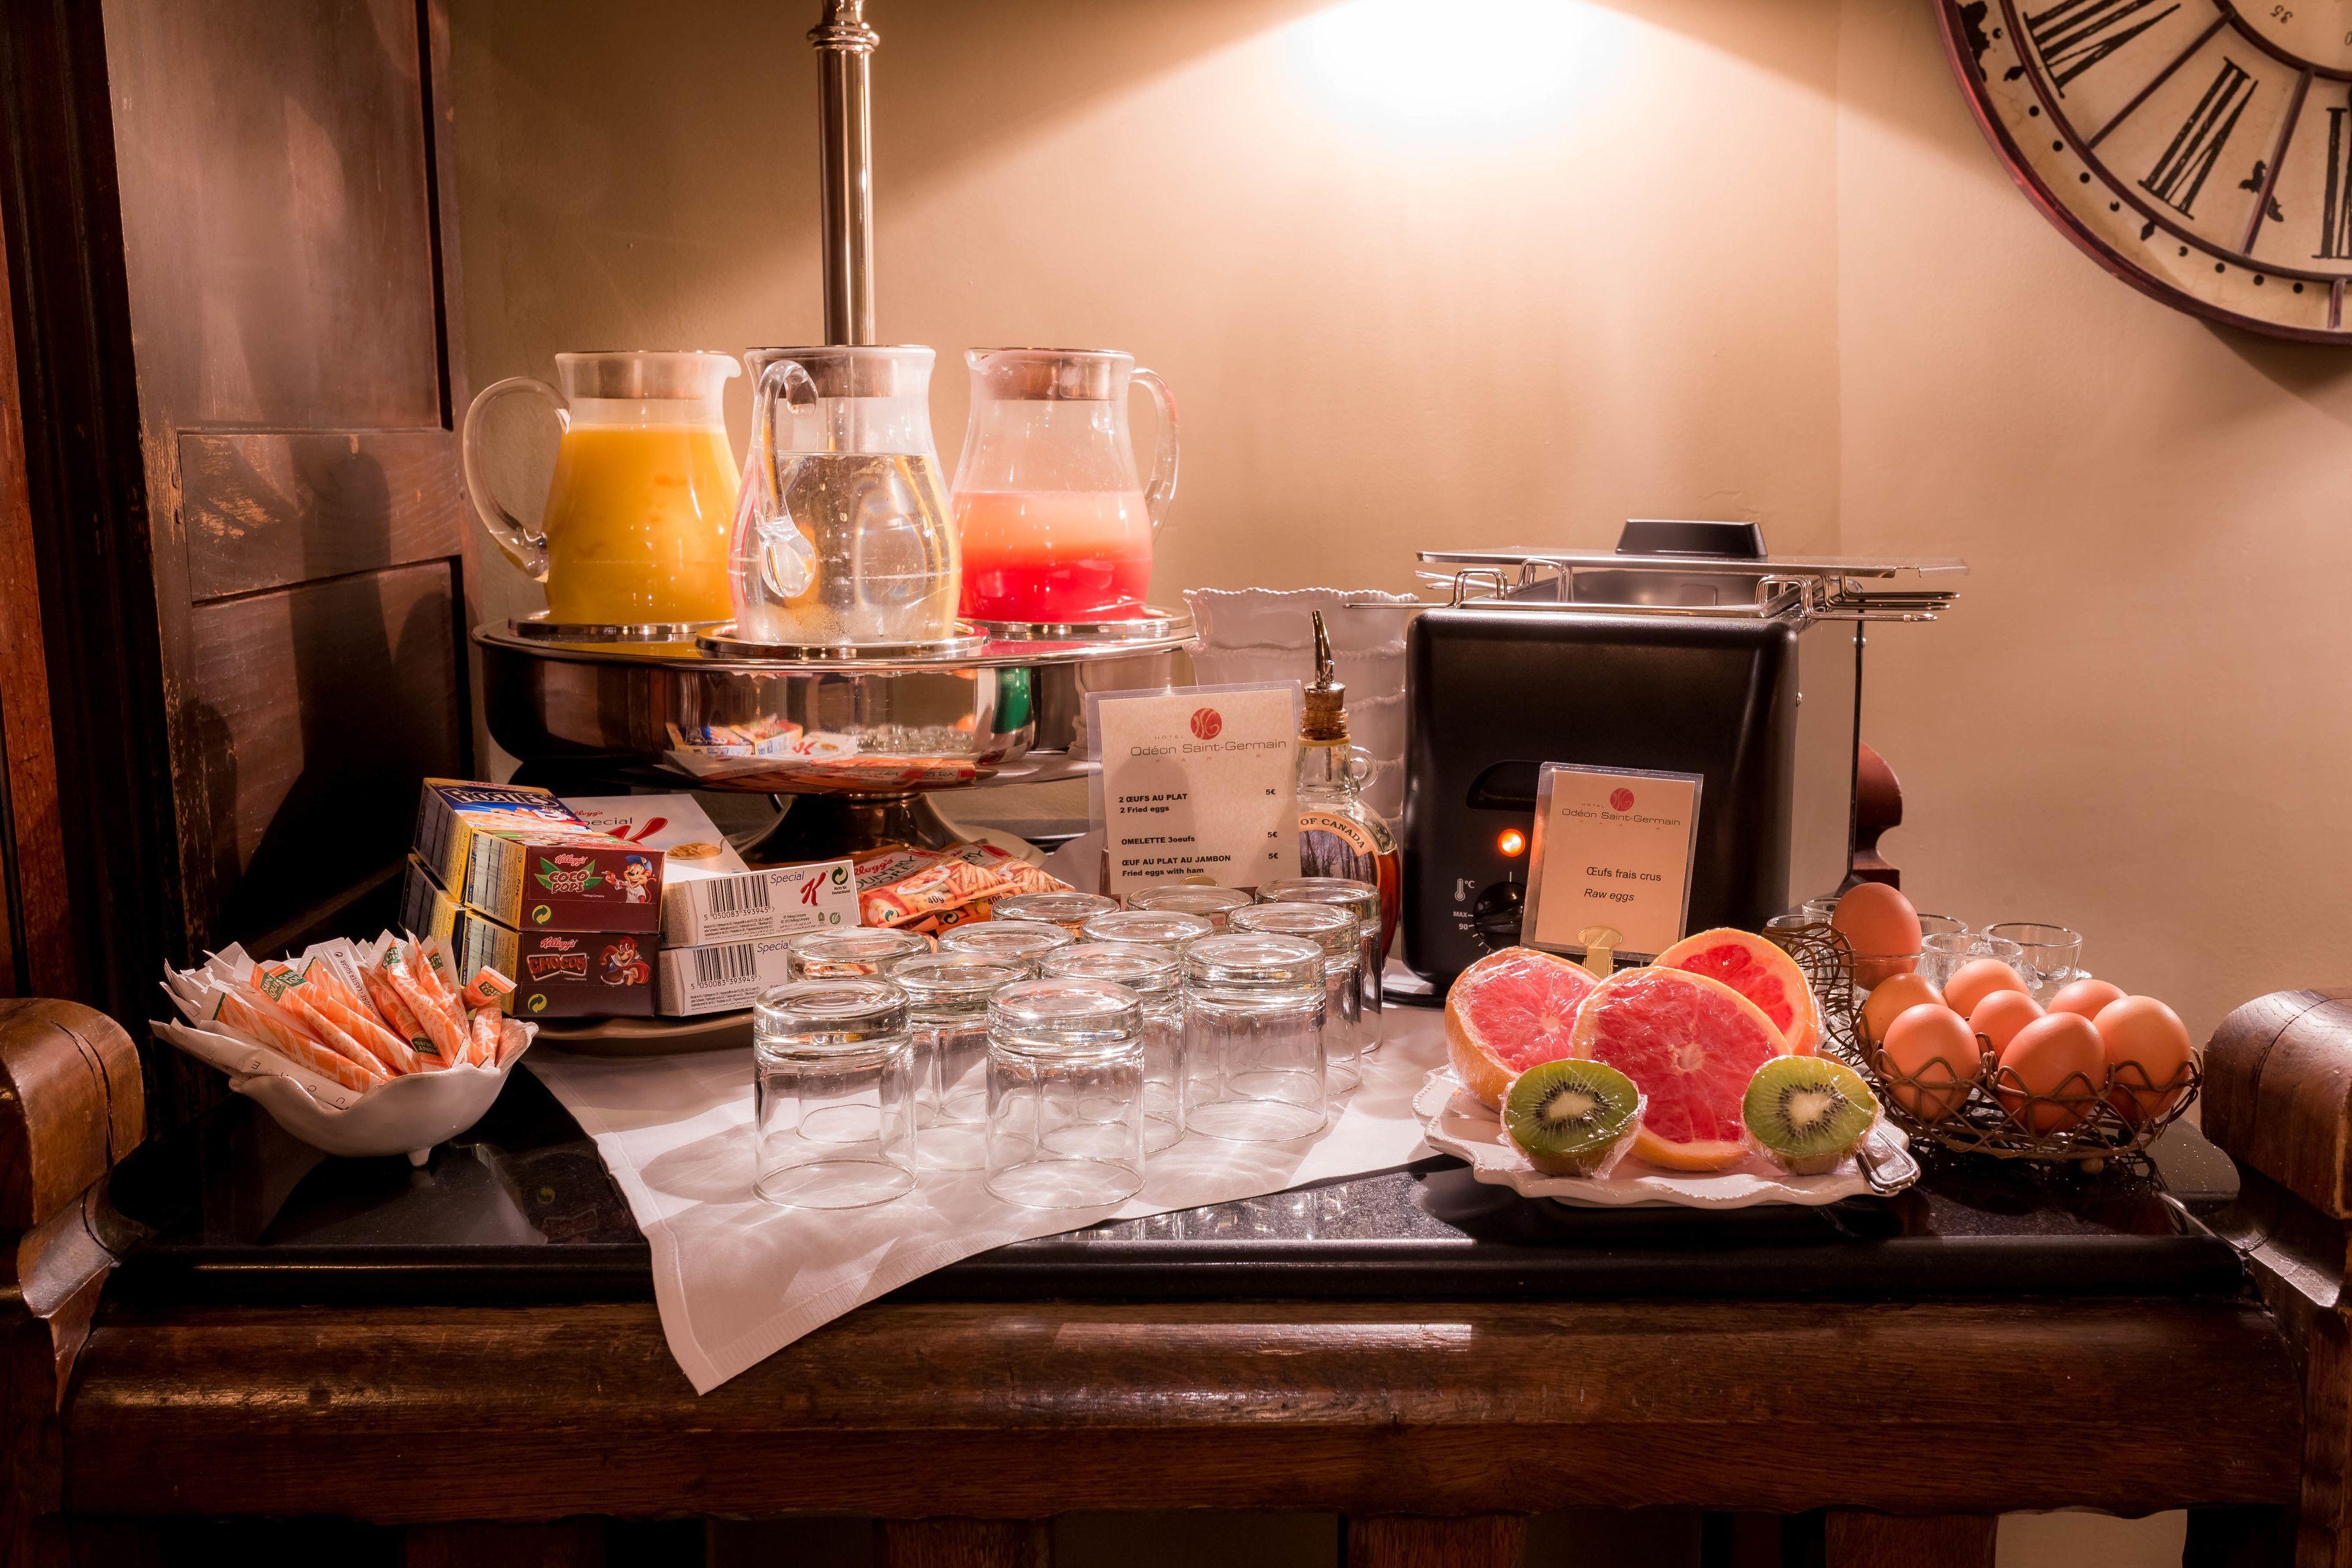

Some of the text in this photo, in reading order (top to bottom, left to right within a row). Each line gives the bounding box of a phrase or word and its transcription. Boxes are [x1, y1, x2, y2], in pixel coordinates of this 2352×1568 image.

[1131, 739, 1286, 756] Odéon Saint-Germain
[1562, 809, 1680, 826] Odéon Saint-Germain
[1321, 818, 1365, 848] CANADA
[555, 853, 587, 866] Kellogg's
[548, 870, 591, 883] COCO
[855, 856, 916, 889] OUNTRY
[1586, 867, 1662, 881] Œufs frais crus
[551, 882, 584, 894] POPS
[770, 871, 826, 906] Special K
[1584, 889, 1634, 902] Raw eggs
[713, 911, 740, 919] 050083
[742, 907, 769, 917] 393945
[540, 937, 576, 951] Kellogg's
[339, 959, 353, 975] SUGAR
[529, 956, 587, 974] CHOCOS
[349, 973, 363, 992] CASTER
[699, 979, 726, 989] 050083
[729, 976, 755, 985] 393945
[360, 993, 374, 1014] OUDRE
